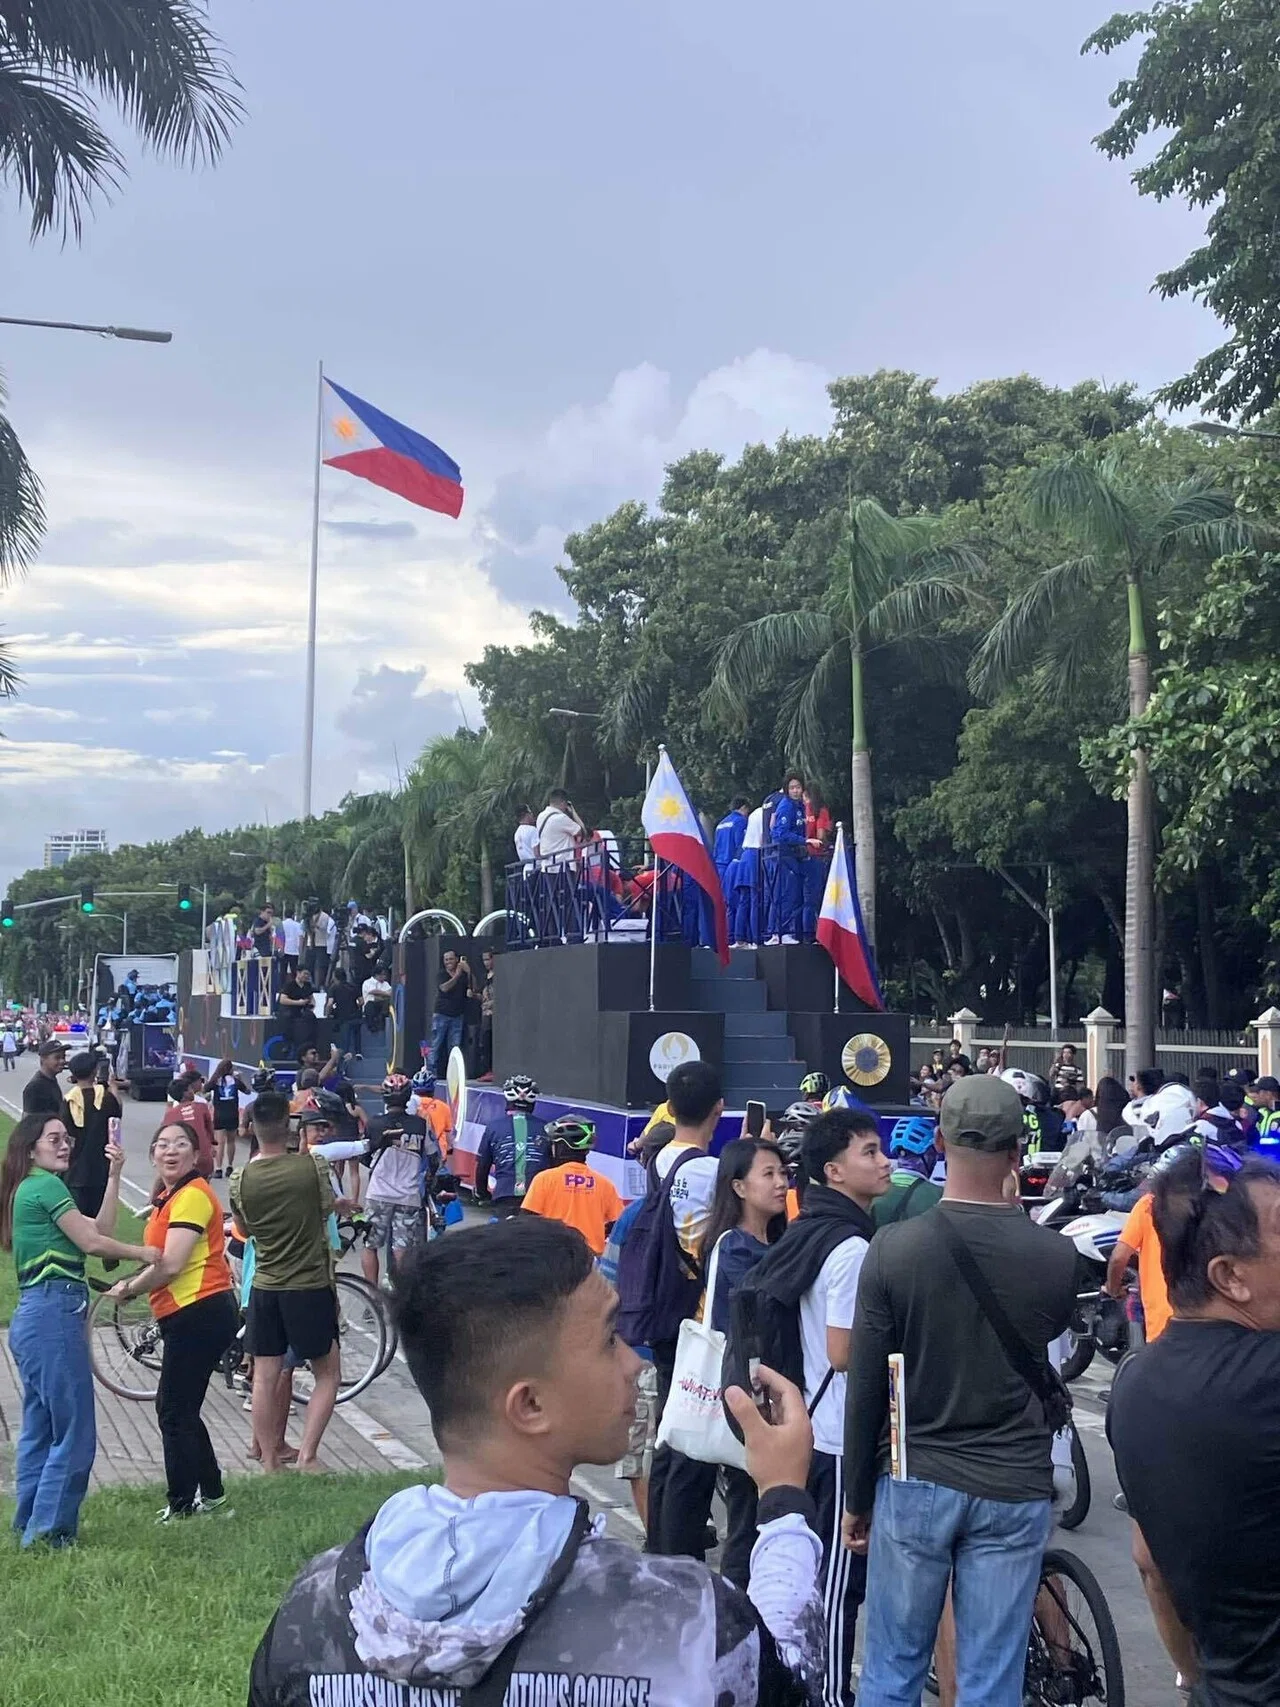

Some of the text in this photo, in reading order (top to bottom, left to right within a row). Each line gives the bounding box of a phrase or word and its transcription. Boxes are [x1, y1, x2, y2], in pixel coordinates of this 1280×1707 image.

[564, 1173, 595, 1188] FPJ
[502, 1672, 651, 1707] ATIONS COURSE
